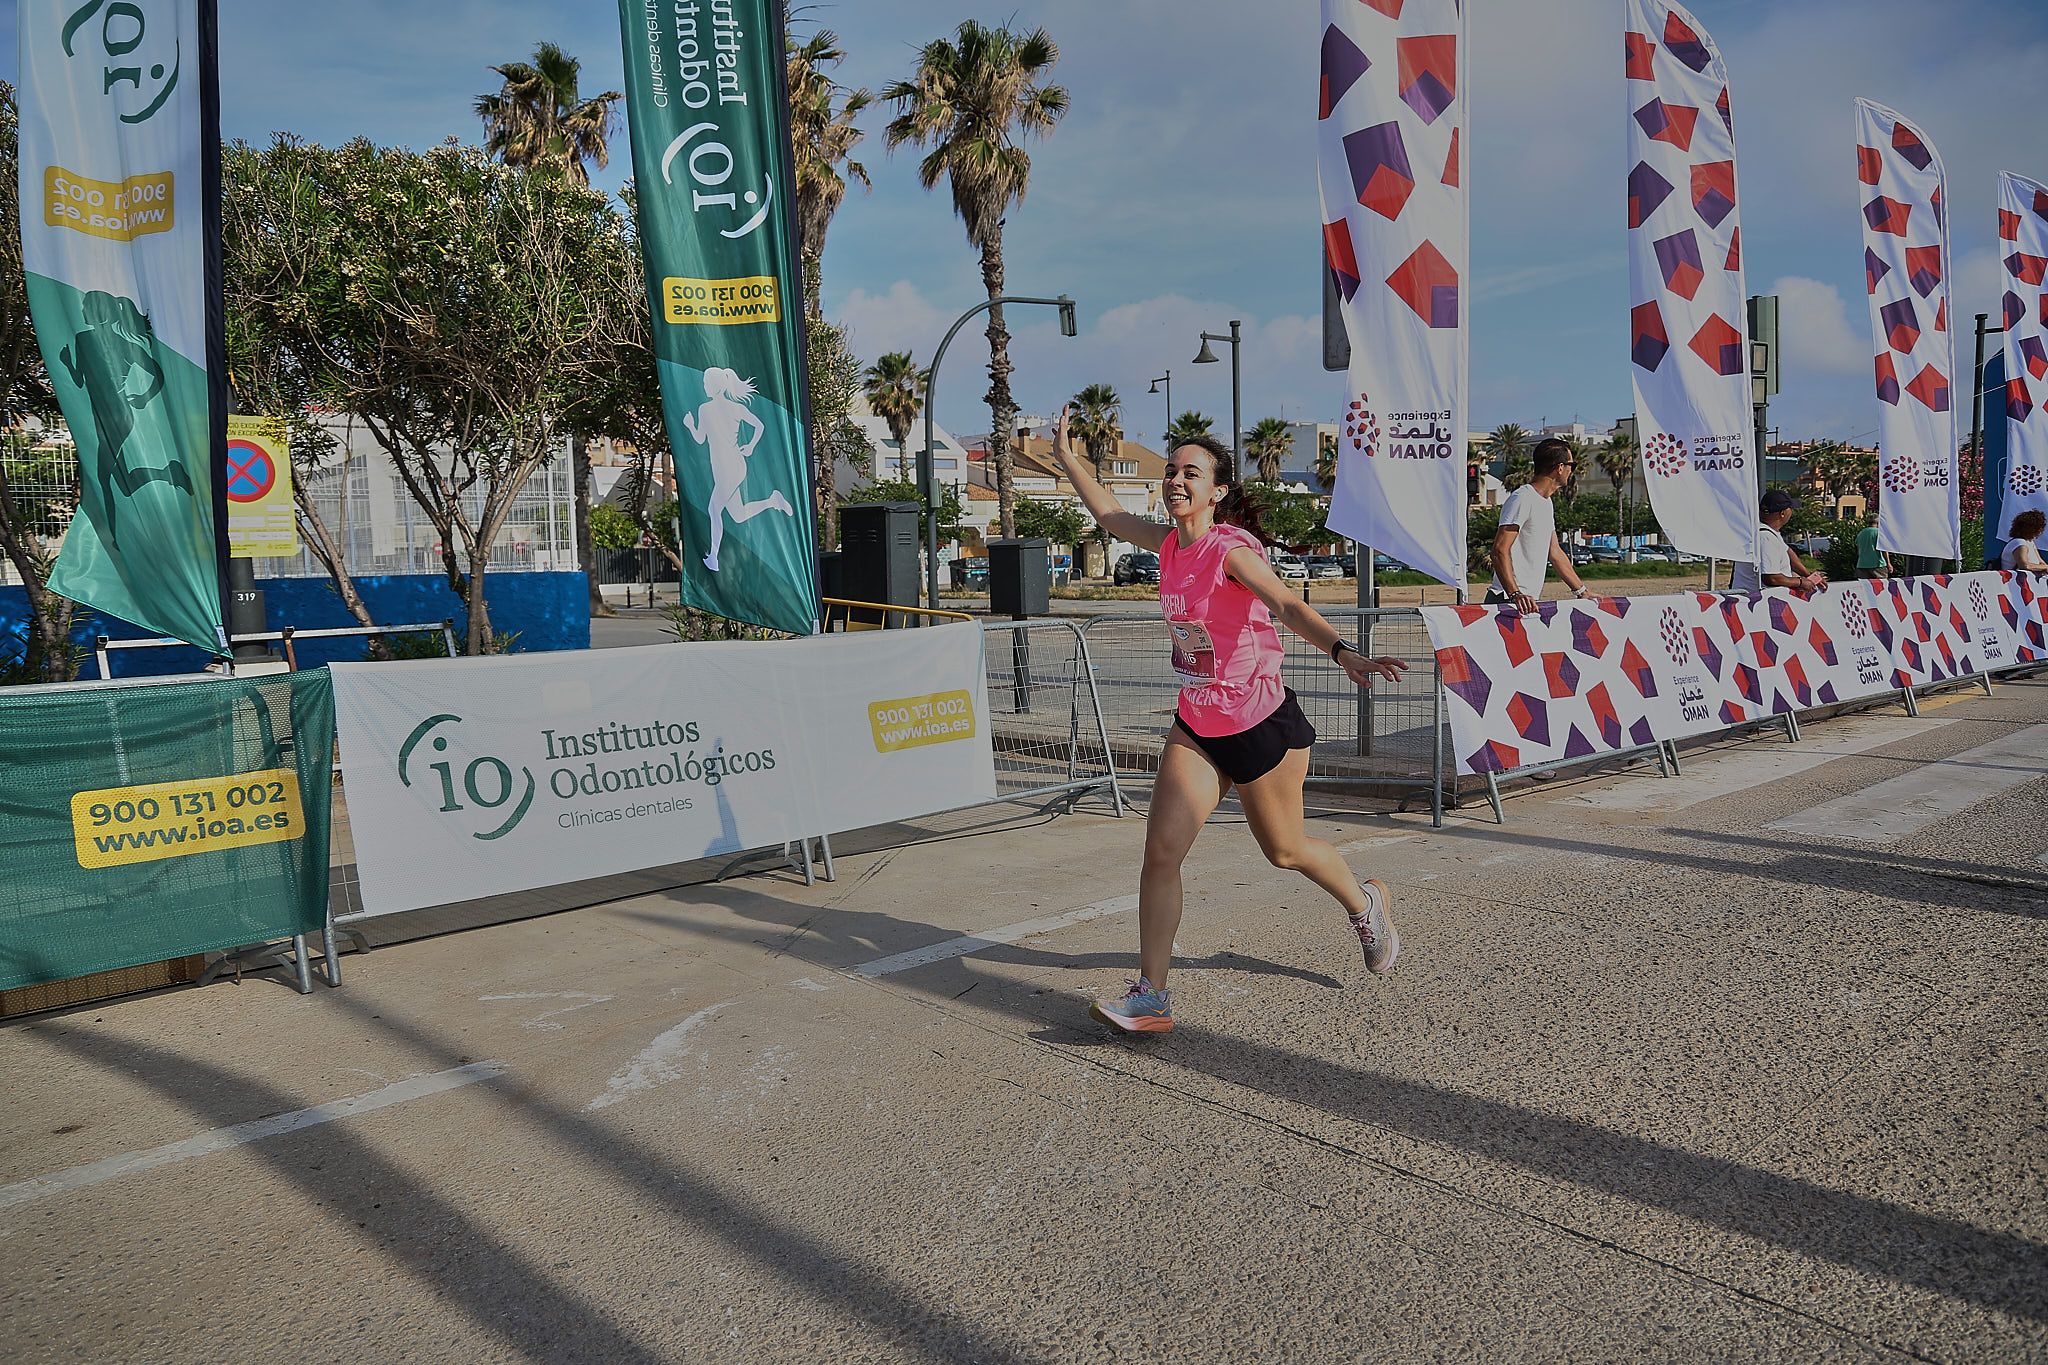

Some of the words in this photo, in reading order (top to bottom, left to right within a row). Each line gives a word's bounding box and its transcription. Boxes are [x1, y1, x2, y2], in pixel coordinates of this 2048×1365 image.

[237, 592, 256, 601] 319
[1984, 647, 2003, 660] OMAN
[1859, 669, 1884, 685] OMAN
[876, 707, 911, 726] 900
[911, 702, 934, 719] 131
[936, 698, 967, 717] 002
[1682, 704, 1710, 722] OMAN
[541, 719, 701, 761] Institutos
[880, 719, 970, 744] www.ioa.es
[550, 746, 777, 800] Odontológicos
[89, 797, 160, 827] 900
[168, 790, 217, 817] 131
[226, 781, 287, 809] 002
[558, 807, 623, 829] Clínicas
[625, 796, 694, 819] dentales
[93, 810, 290, 854] www.ioa.es
